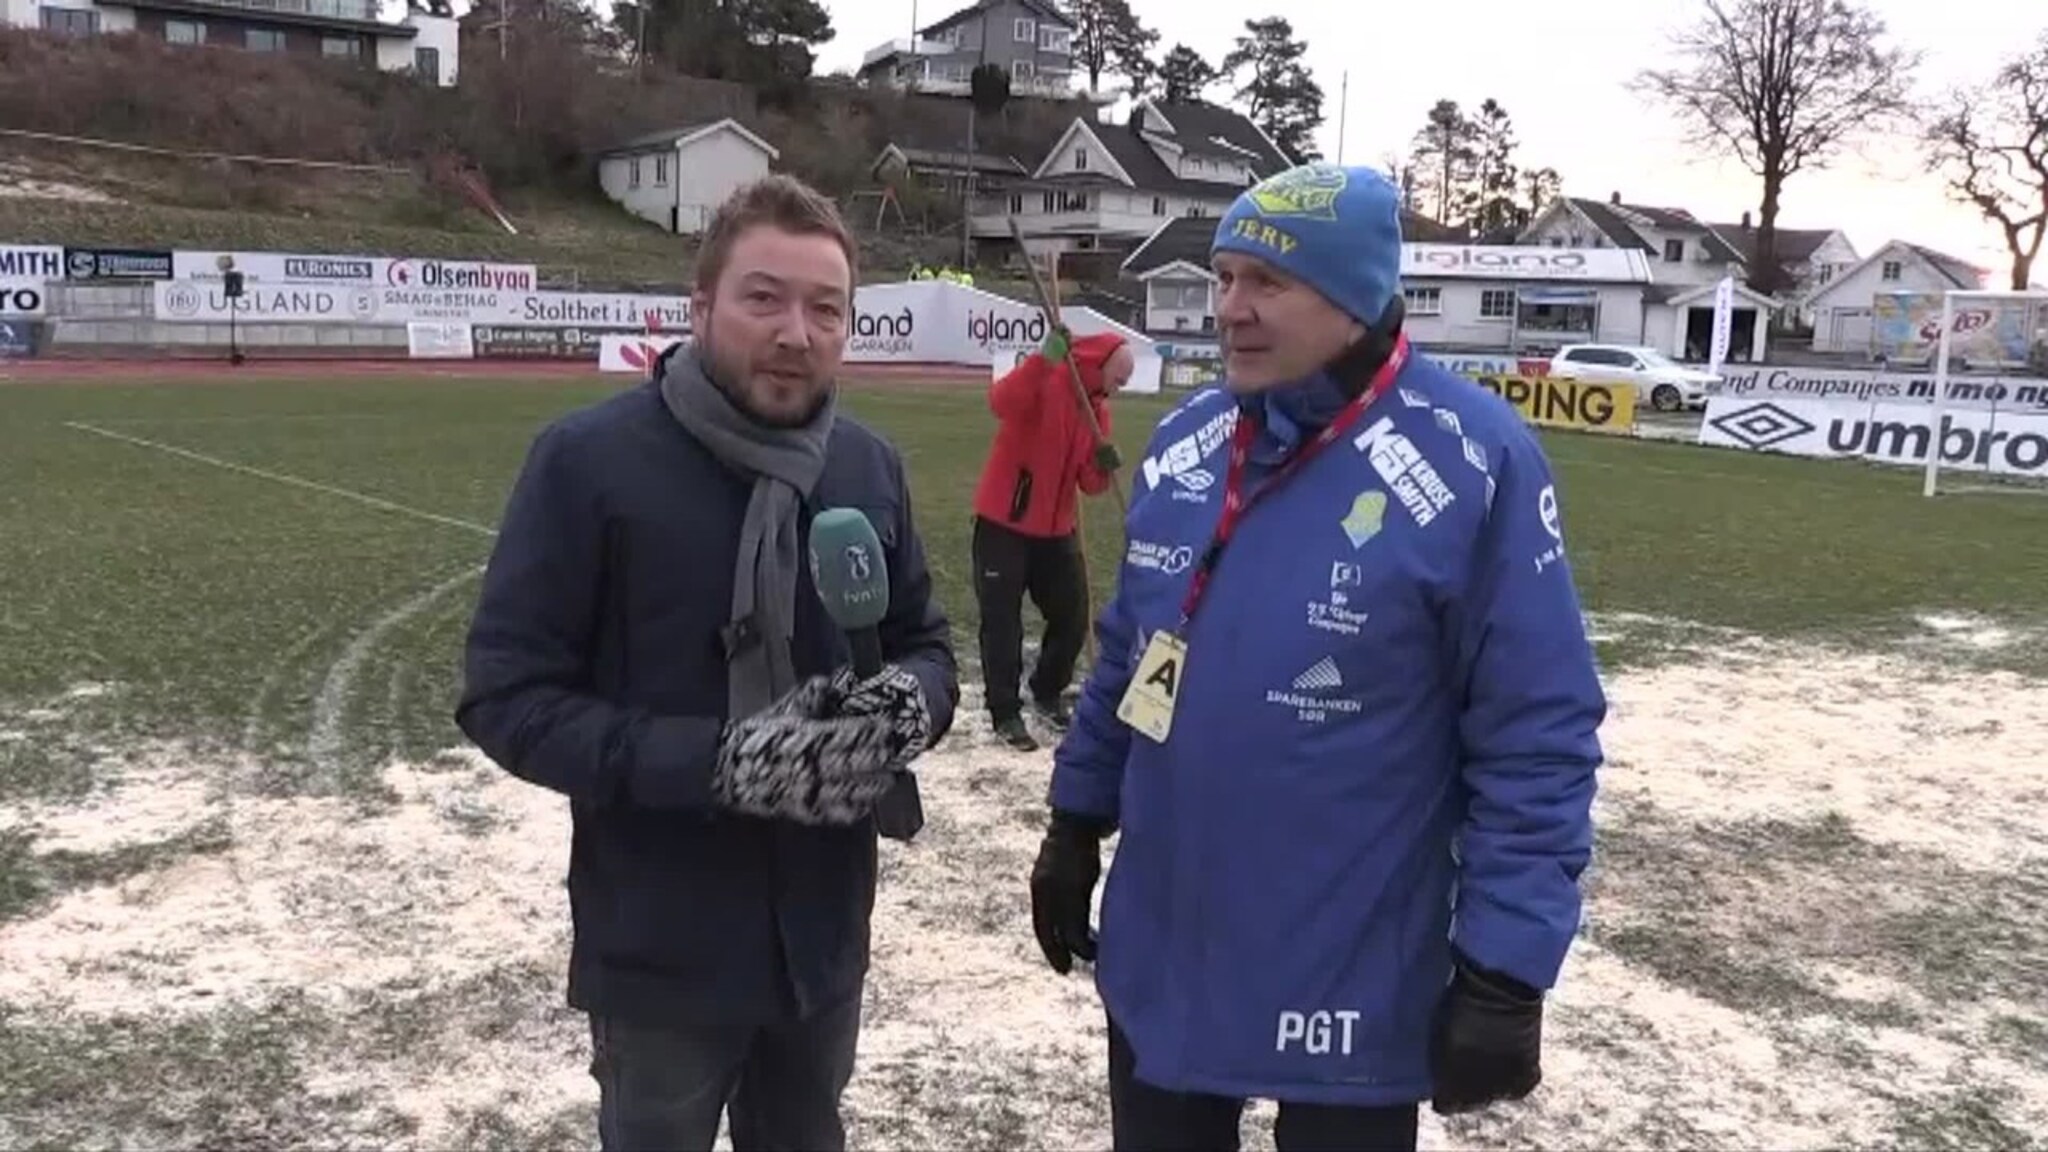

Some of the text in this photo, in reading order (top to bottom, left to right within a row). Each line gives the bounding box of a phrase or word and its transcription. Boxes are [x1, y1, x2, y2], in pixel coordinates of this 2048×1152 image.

[1232, 219, 1297, 255] JERV
[288, 261, 368, 276] EURONICS
[422, 263, 530, 291] Olsenbygg
[443, 293, 498, 308] BEHAG
[524, 297, 609, 321] Stolthet
[616, 299, 621, 321] i
[627, 302, 638, 322] å
[851, 306, 914, 337] land
[968, 310, 1046, 347] igland
[1767, 370, 1901, 400] Companies
[1827, 415, 2048, 470] umbro
[1392, 475, 1438, 528] SMITH
[1408, 459, 1457, 513] KRUSE
[1145, 658, 1176, 699] A
[1266, 690, 1362, 713] SPAREBANKEN
[1276, 1009, 1361, 1055] PGT
